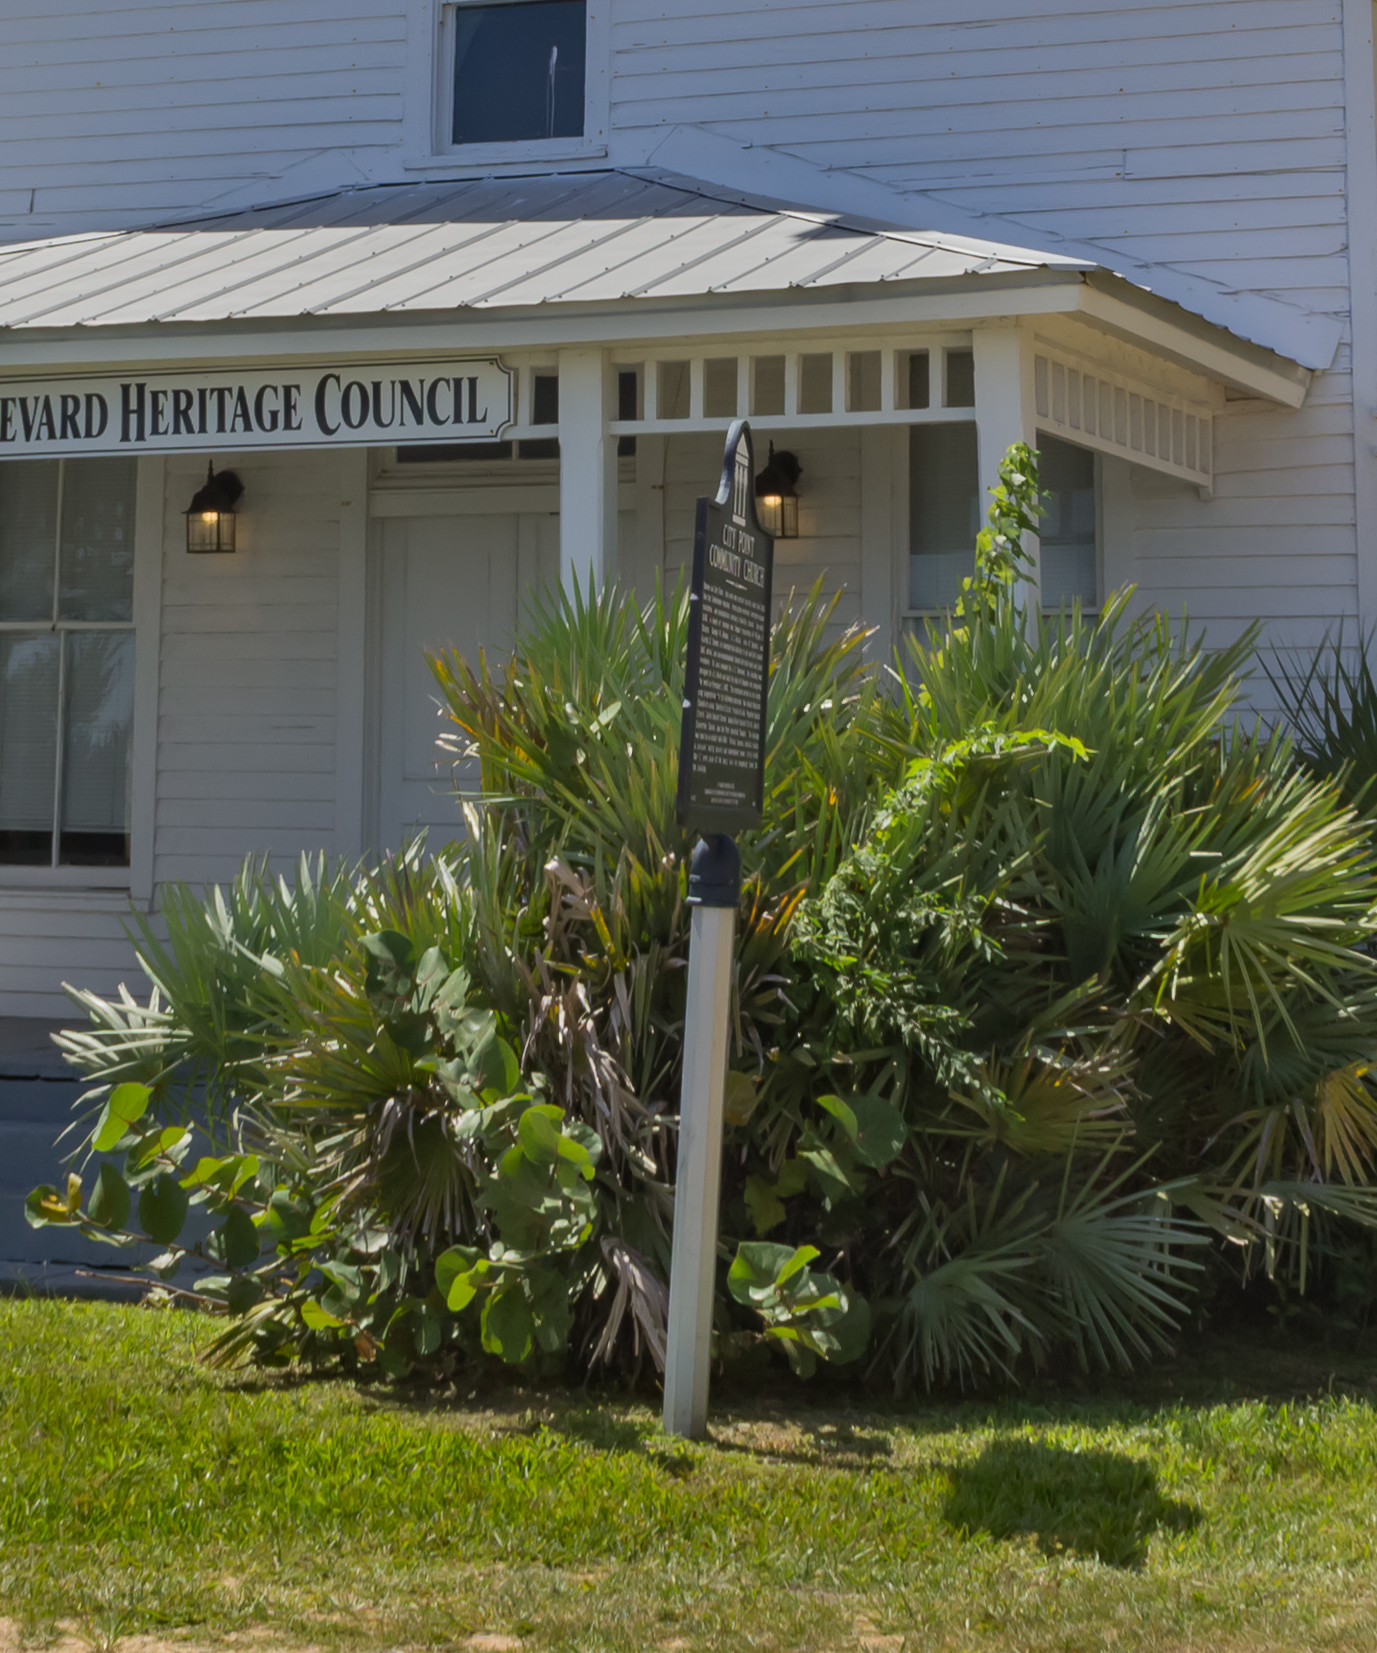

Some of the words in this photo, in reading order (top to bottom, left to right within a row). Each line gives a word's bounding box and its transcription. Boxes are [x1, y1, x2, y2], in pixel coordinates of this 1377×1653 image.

[120, 382, 303, 443] HERITAGE
[314, 373, 488, 436] COUNCIL
[723, 524, 737, 549] CITY
[738, 529, 755, 557] POINT
[743, 559, 765, 588] CHURCH
